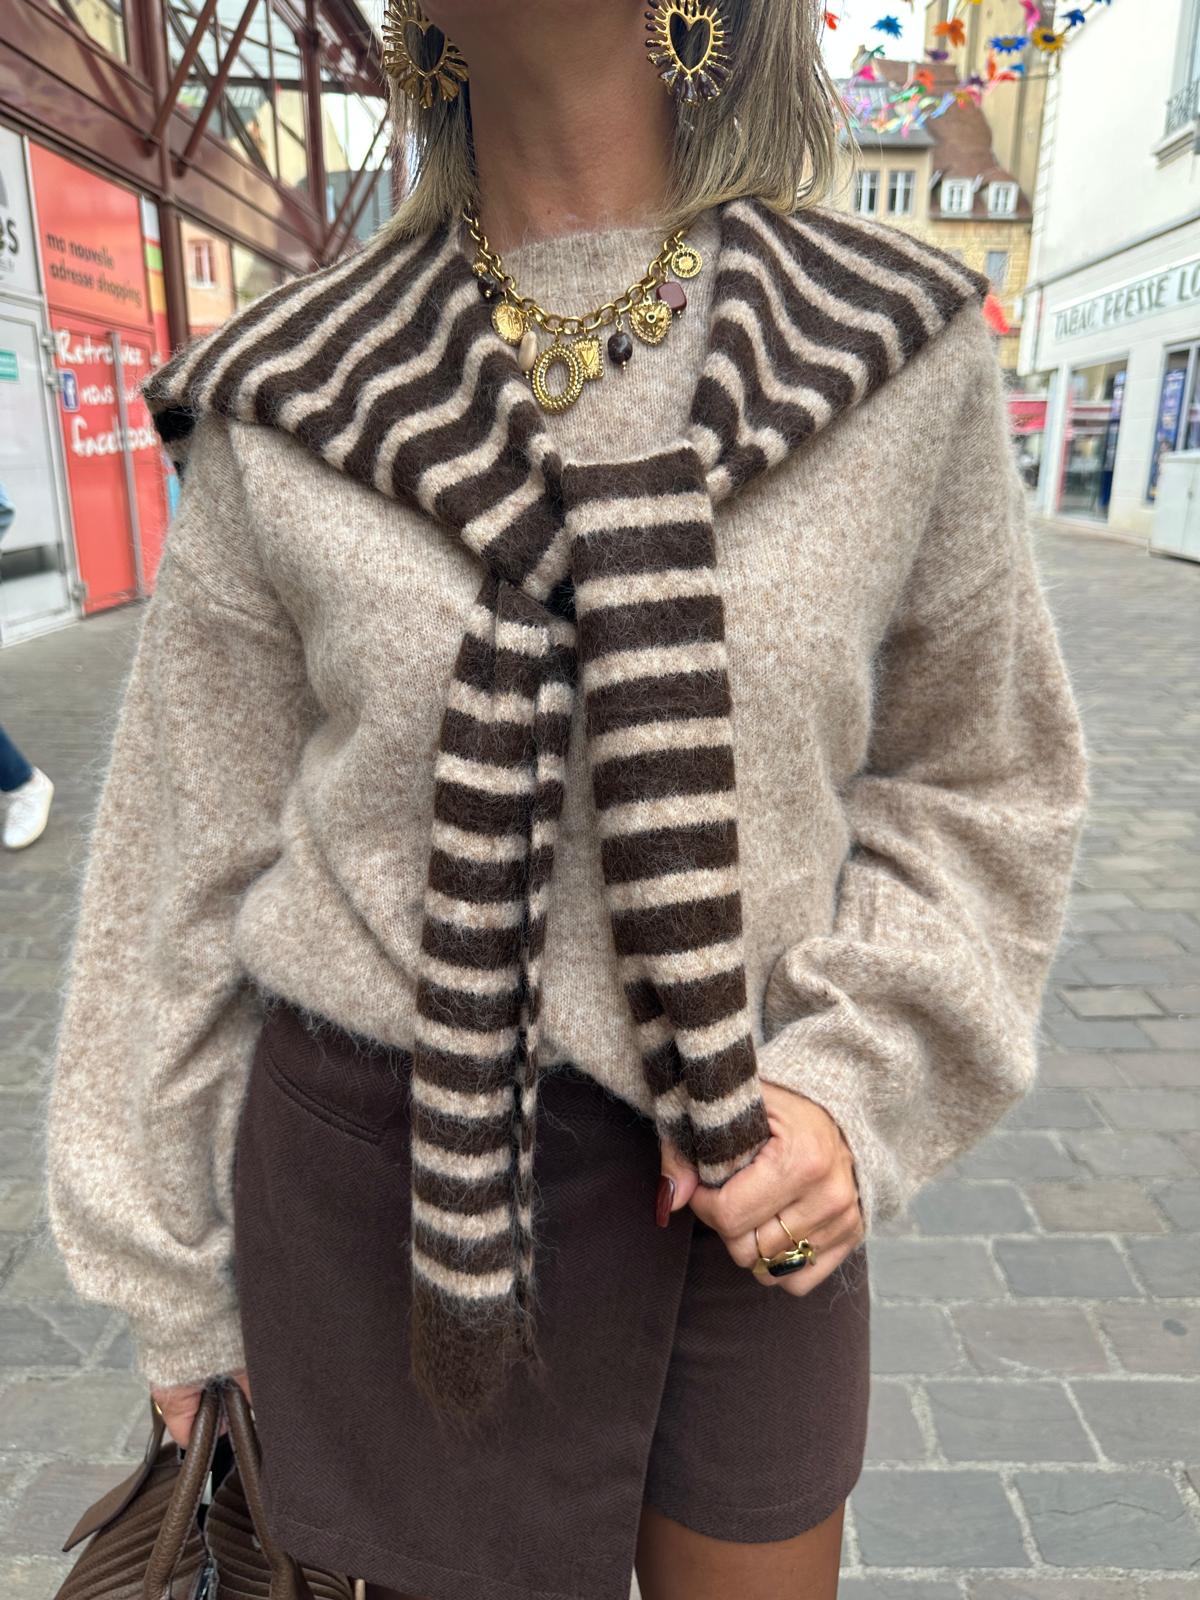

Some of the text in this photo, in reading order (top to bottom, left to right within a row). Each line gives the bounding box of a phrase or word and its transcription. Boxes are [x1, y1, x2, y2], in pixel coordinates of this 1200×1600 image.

[49, 257, 95, 290] adresse
[97, 271, 143, 309] shopping
[1055, 300, 1098, 338] TABAC
[1103, 275, 1170, 325] PRESSE
